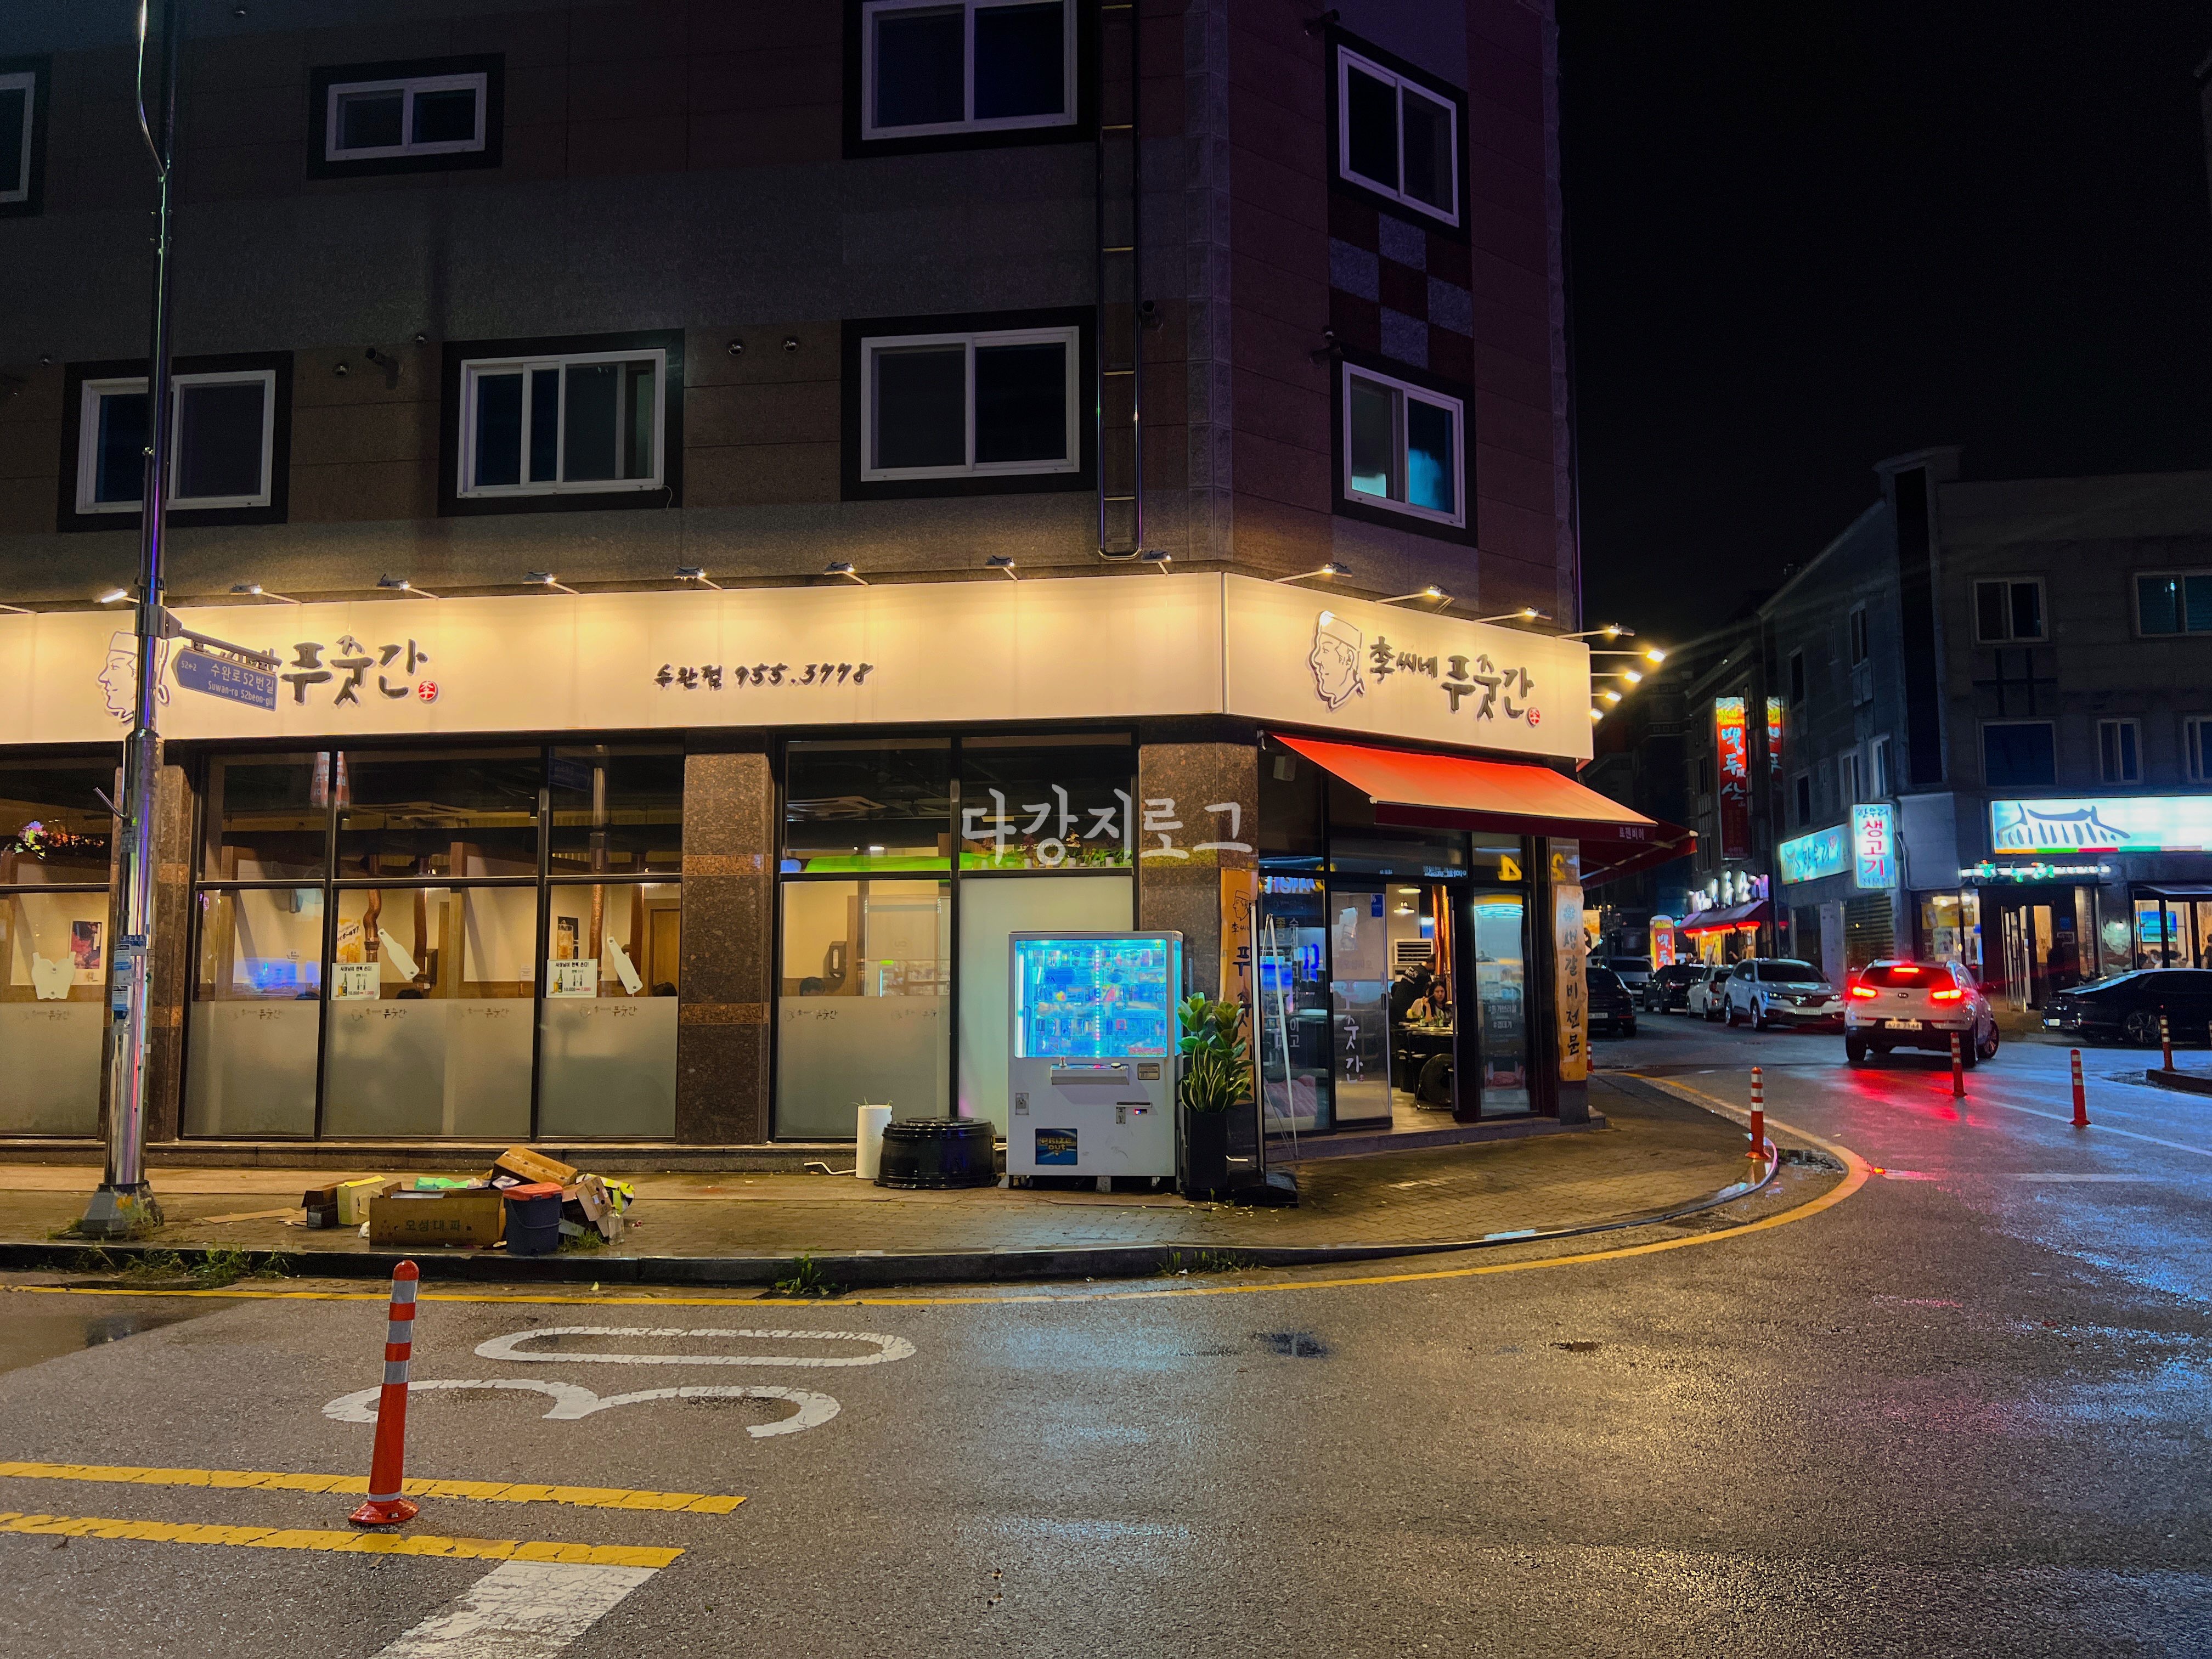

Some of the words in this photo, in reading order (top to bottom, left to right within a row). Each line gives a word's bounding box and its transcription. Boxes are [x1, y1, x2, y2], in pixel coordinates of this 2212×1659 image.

[208, 680, 239, 697] Suwan-ro
[240, 690, 273, 707] 52beon-gil
[280, 635, 428, 706] 푸줏간
[656, 663, 723, 691] 수완점
[1441, 654, 1535, 719] 푸줏간
[1862, 820, 1886, 877] 생고기
